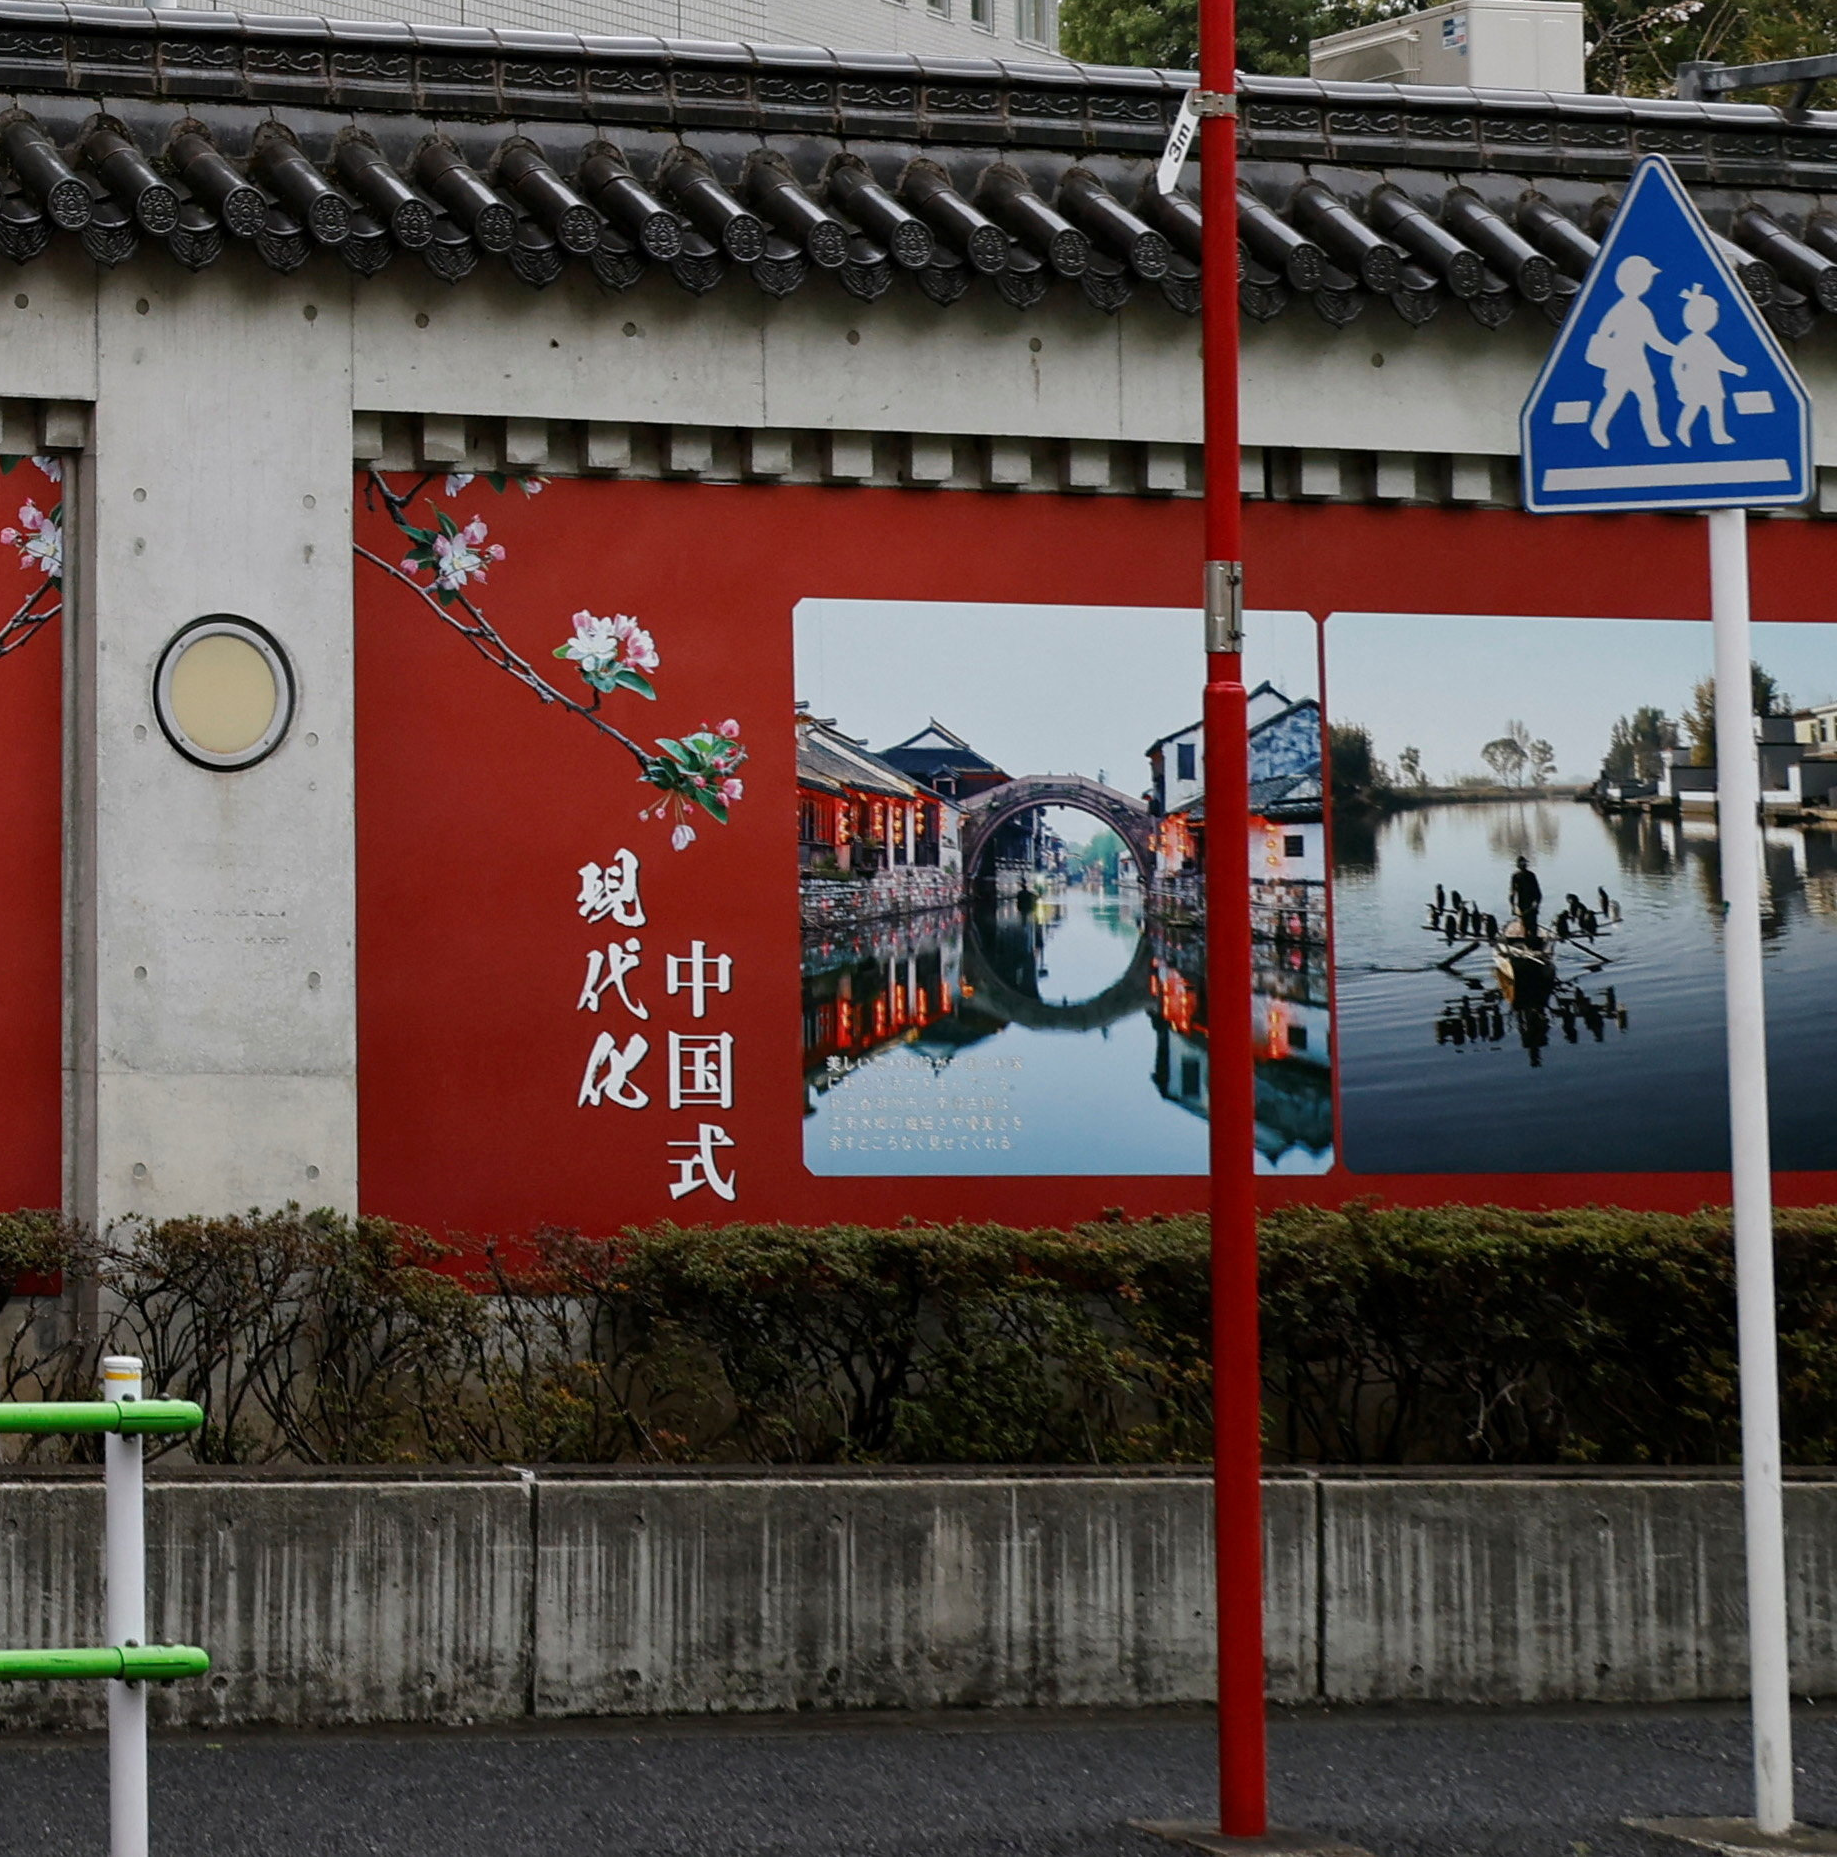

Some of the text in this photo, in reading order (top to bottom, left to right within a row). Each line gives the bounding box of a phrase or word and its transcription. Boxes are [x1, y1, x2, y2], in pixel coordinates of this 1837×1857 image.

[1168, 123, 1191, 163] 3m
[576, 847, 650, 1109] 現代化
[666, 940, 737, 1202] 中国式
